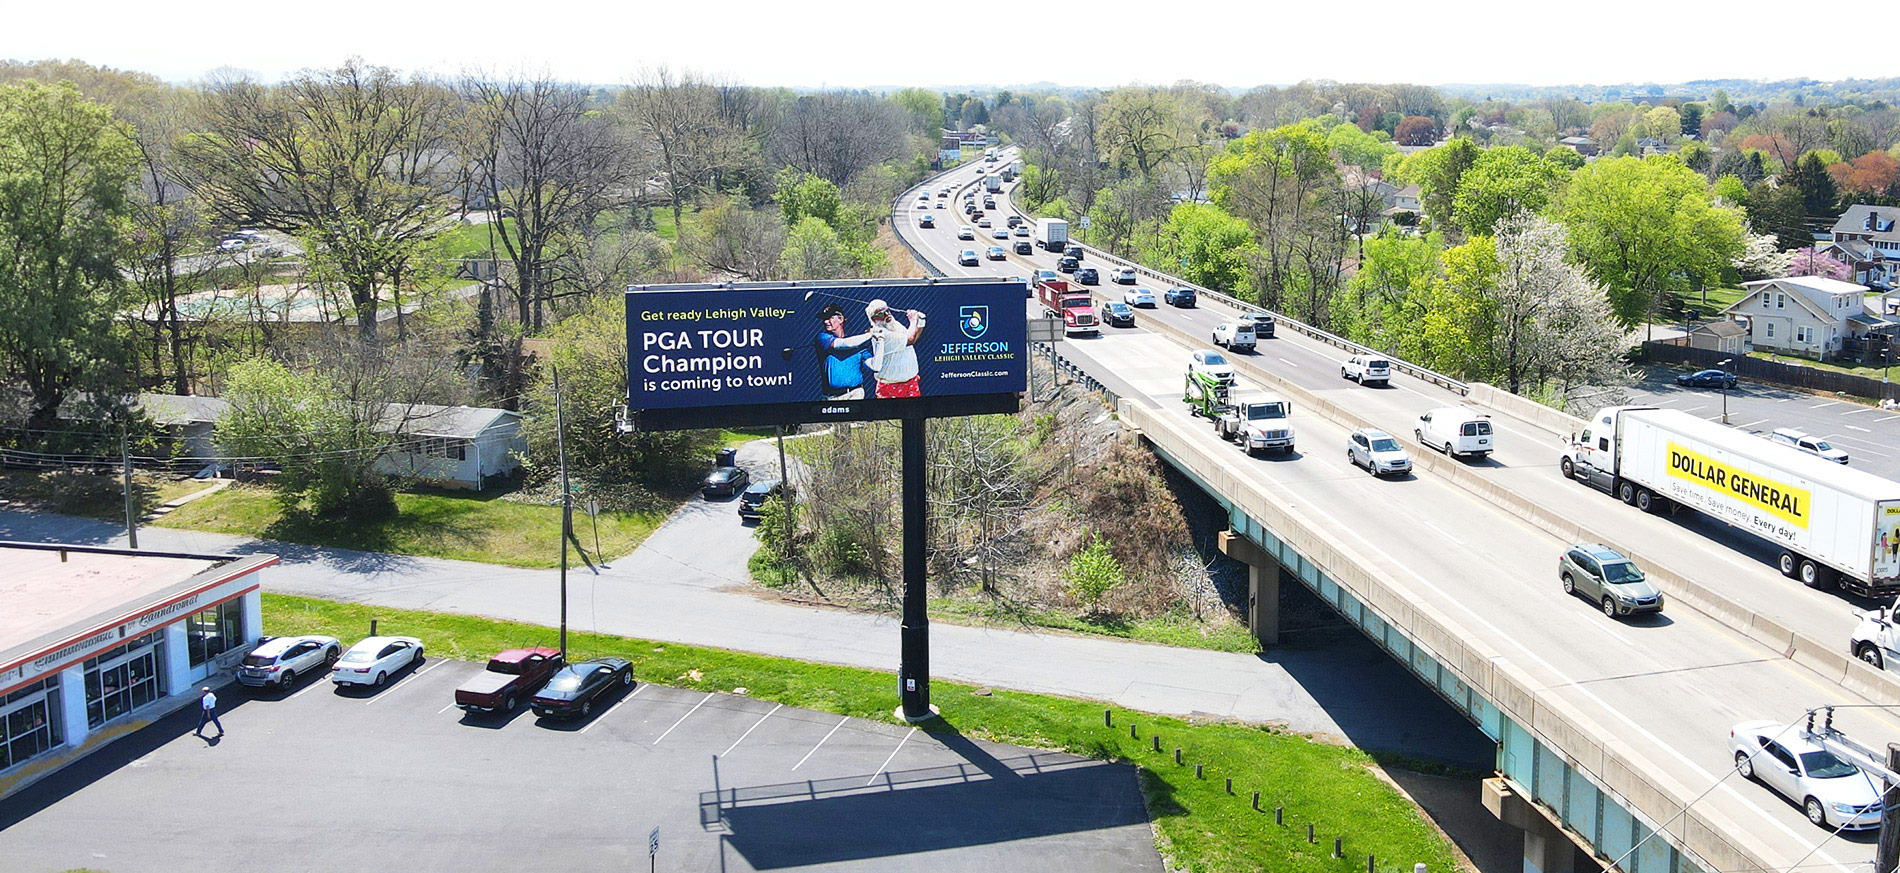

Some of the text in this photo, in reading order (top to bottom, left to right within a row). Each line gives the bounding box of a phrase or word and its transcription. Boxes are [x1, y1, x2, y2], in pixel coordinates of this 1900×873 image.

[641, 311, 664, 321] Get
[667, 309, 701, 321] ready
[705, 308, 747, 321] Lehigh
[643, 329, 764, 350] PGA TOUR
[940, 341, 1009, 354] JEFFERSON
[643, 353, 762, 375] Champion
[643, 372, 793, 392] is coming to town!
[940, 370, 1009, 379] JeffersonClassic.com
[821, 406, 850, 414] adams
[1672, 451, 1802, 517] DOLLAR GENERAL
[1672, 482, 1688, 495] Save
[1708, 496, 1725, 511] Save
[1754, 515, 1776, 533] Every
[1778, 526, 1796, 540] day!
